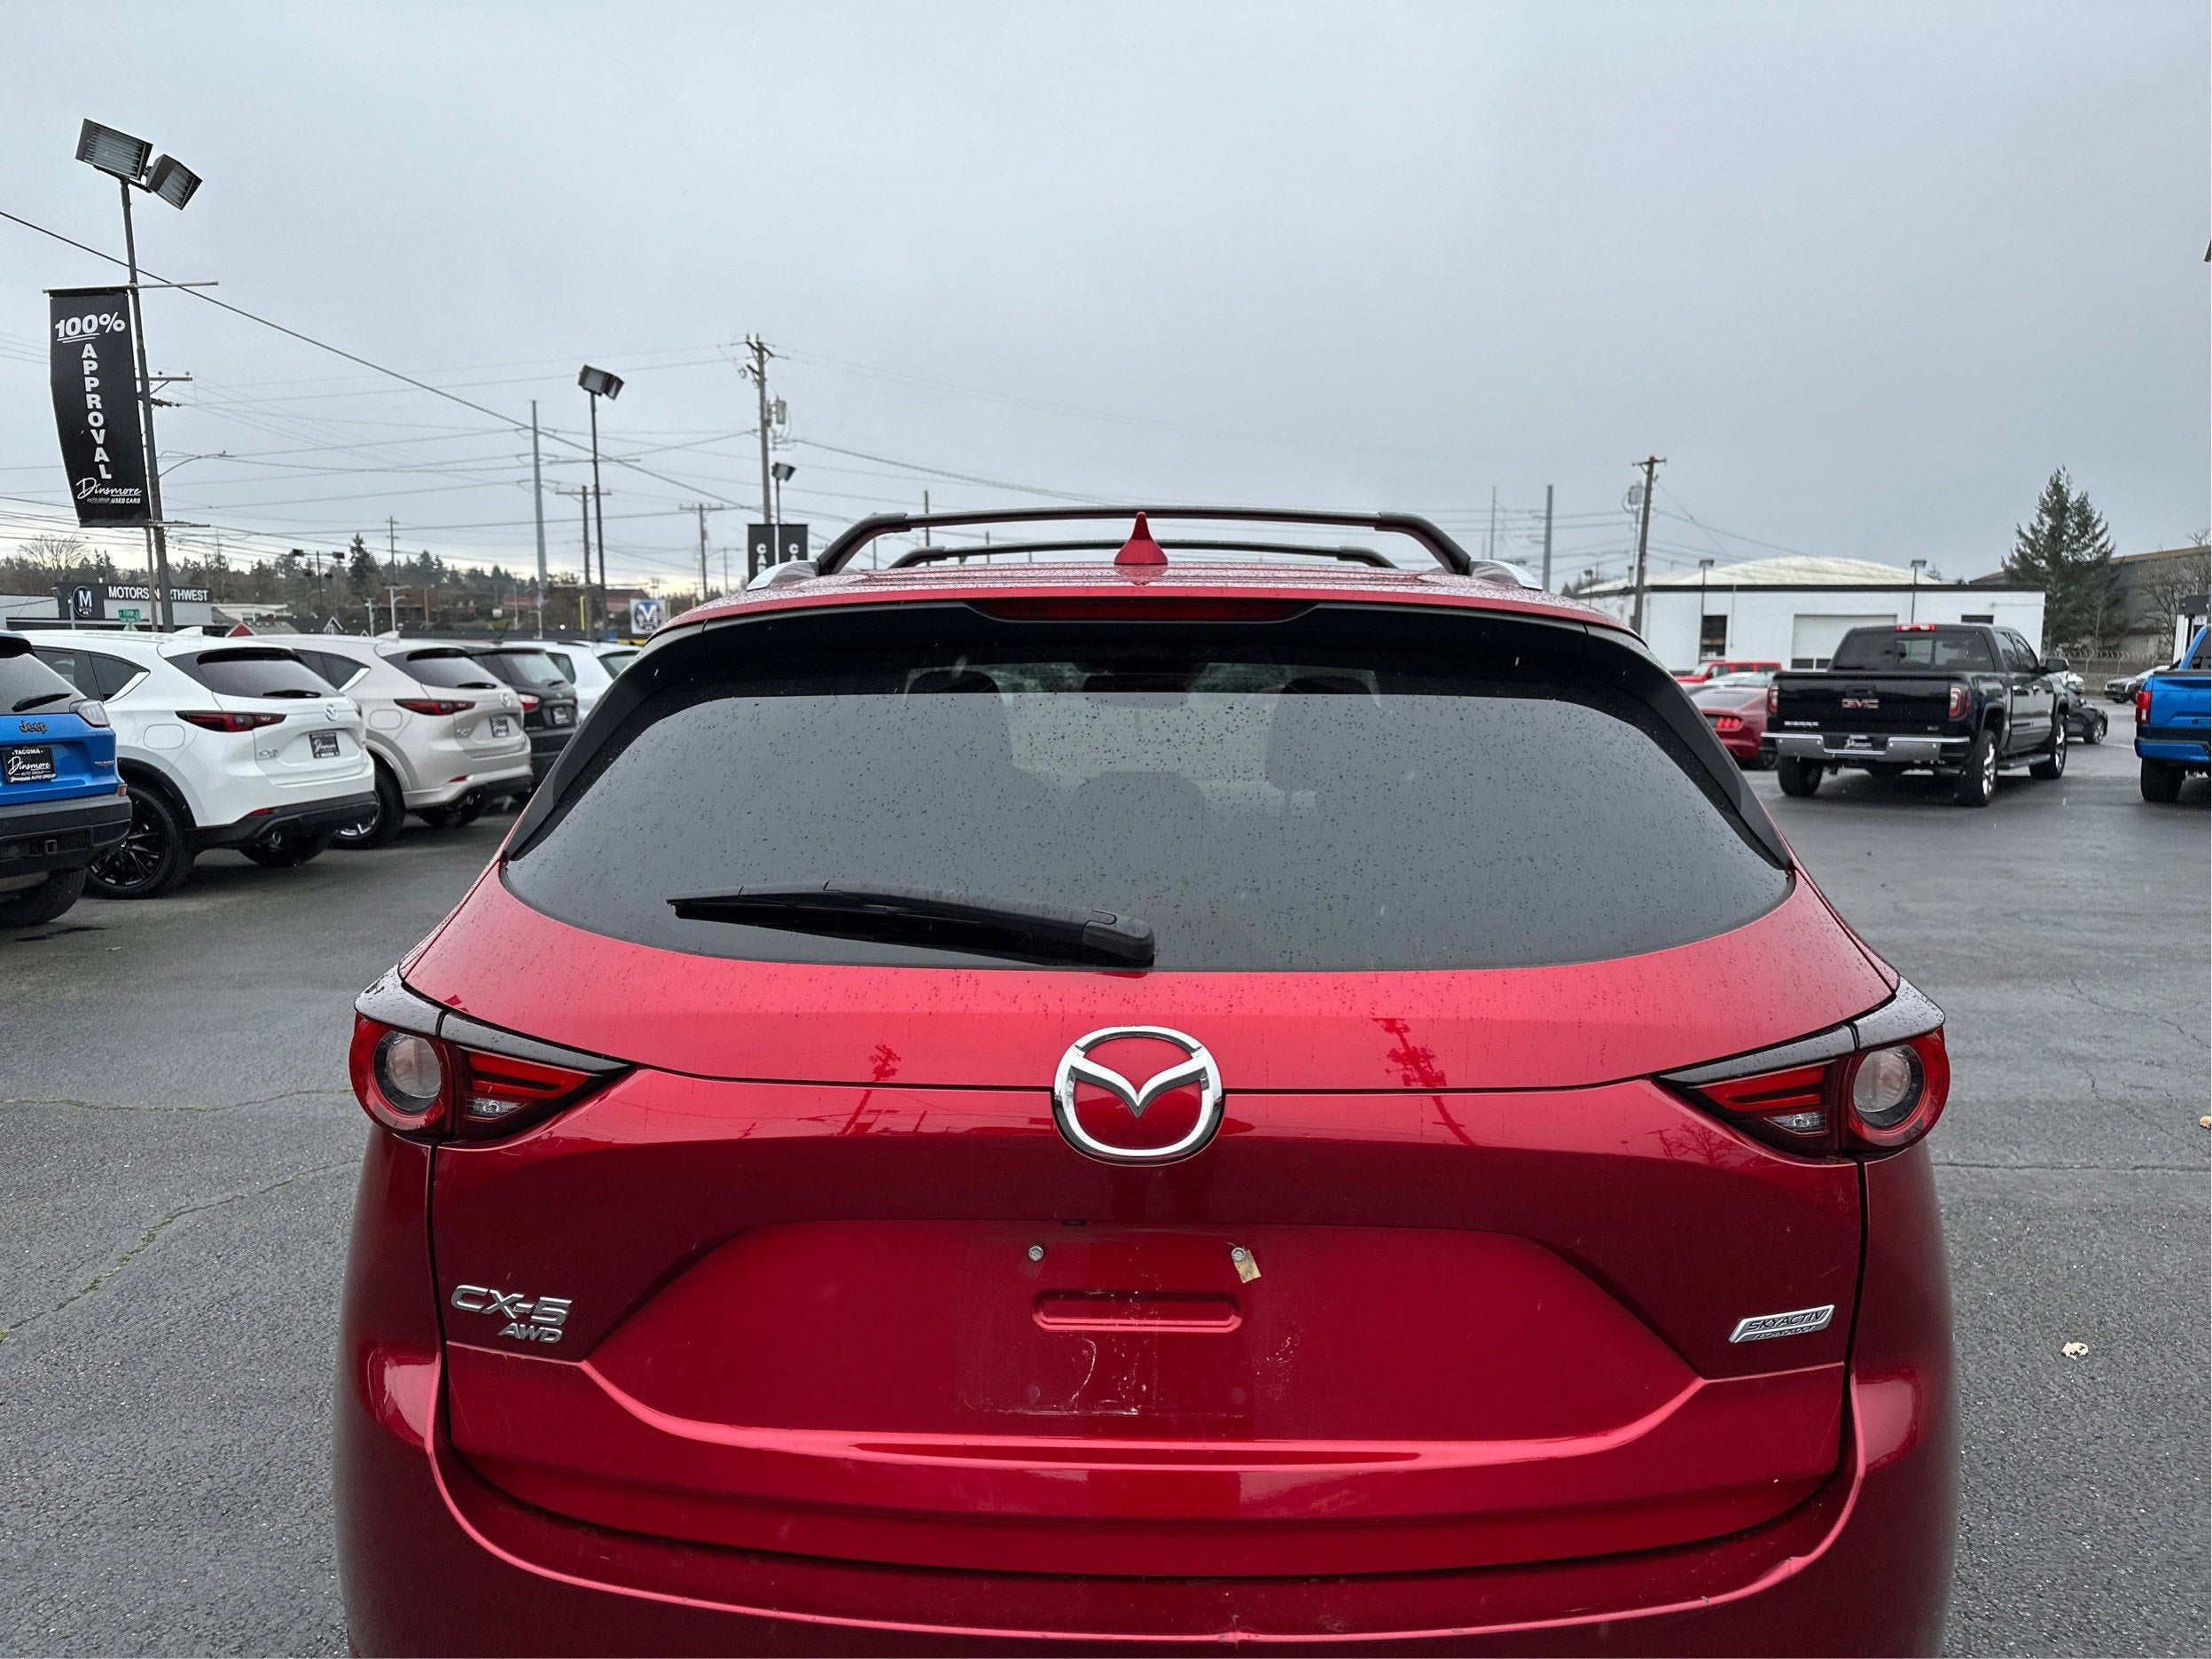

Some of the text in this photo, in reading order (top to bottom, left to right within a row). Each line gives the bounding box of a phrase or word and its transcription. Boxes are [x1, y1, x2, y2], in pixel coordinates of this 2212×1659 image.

[55, 311, 126, 339] 100%
[81, 343, 113, 480] APPROVAL
[75, 477, 142, 499] Dinsmore
[107, 585, 209, 602] MOTORS NTHWEST
[19, 720, 48, 734] Jeep
[7, 756, 51, 775] Dinsmore
[450, 1284, 573, 1326] CX-5
[1747, 1310, 1829, 1331] SKYACTIV
[496, 1322, 564, 1343] AWD
[1752, 1326, 1816, 1340] TECHNOLOGY
